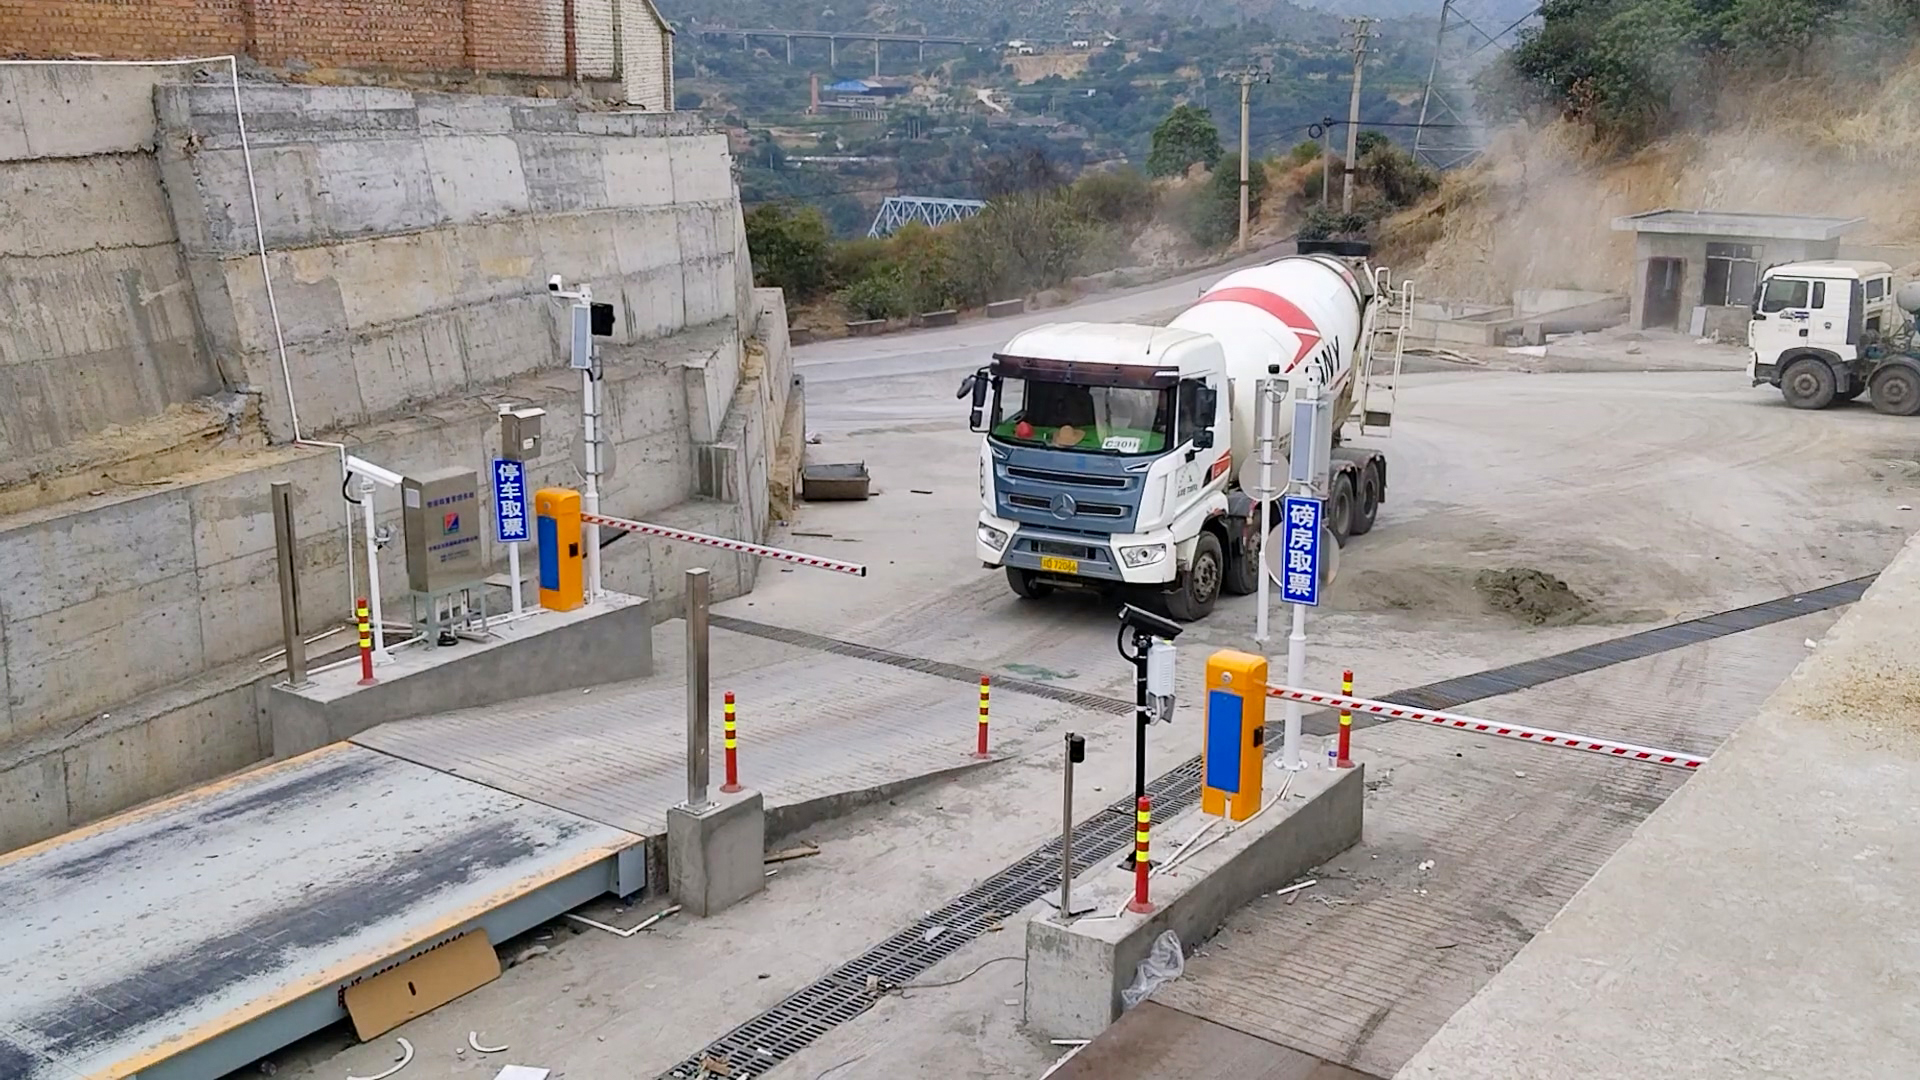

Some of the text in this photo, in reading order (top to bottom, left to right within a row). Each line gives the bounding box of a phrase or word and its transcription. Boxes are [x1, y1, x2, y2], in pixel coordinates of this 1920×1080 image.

[498, 463, 525, 536] 停车取票
[1288, 503, 1316, 597] 磅房取票
